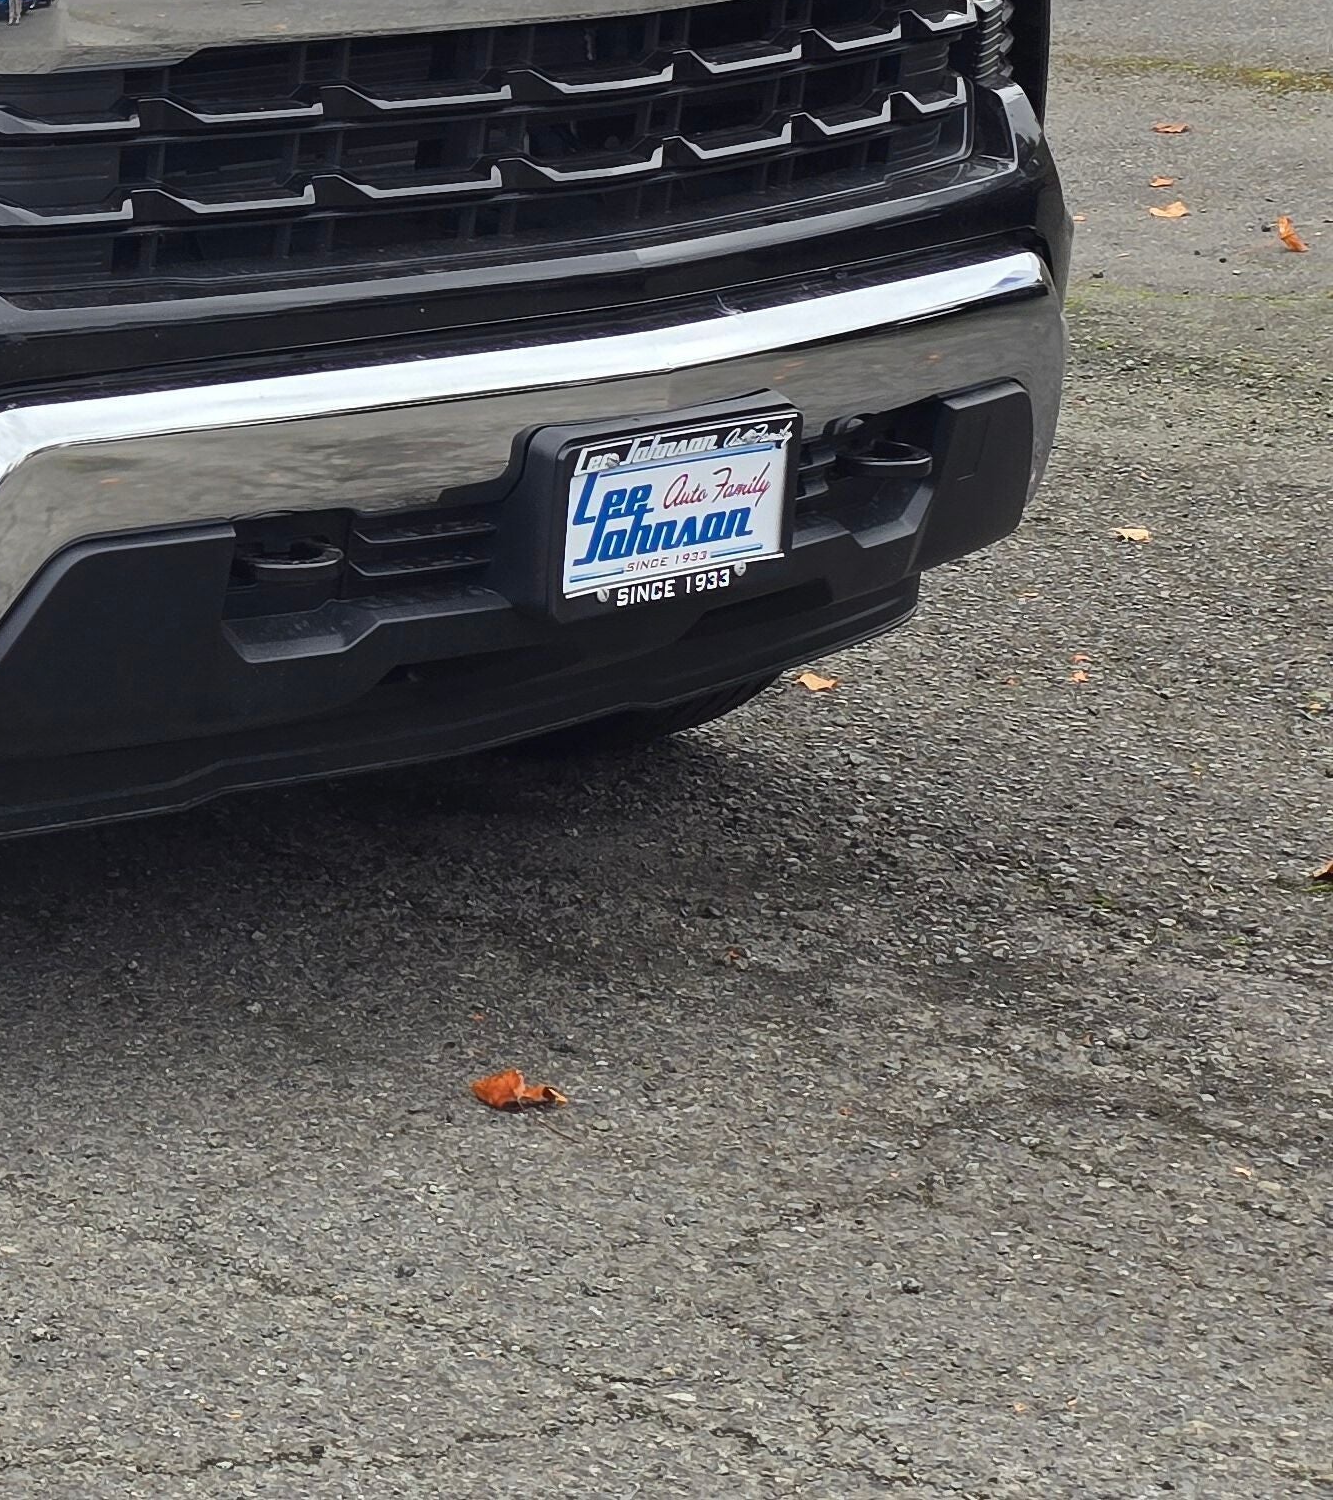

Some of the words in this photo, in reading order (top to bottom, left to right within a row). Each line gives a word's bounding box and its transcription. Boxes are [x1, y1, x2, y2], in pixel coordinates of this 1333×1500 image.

[574, 448, 620, 477] Lee
[619, 434, 718, 466] Johnson
[572, 472, 653, 526] Lee
[663, 473, 708, 510] Auto
[712, 461, 771, 507] Family
[572, 503, 754, 567] Johnson
[626, 556, 669, 573] SINCE
[675, 550, 708, 565] 1933
[616, 579, 676, 607] SINCE
[686, 569, 730, 594] 1933
